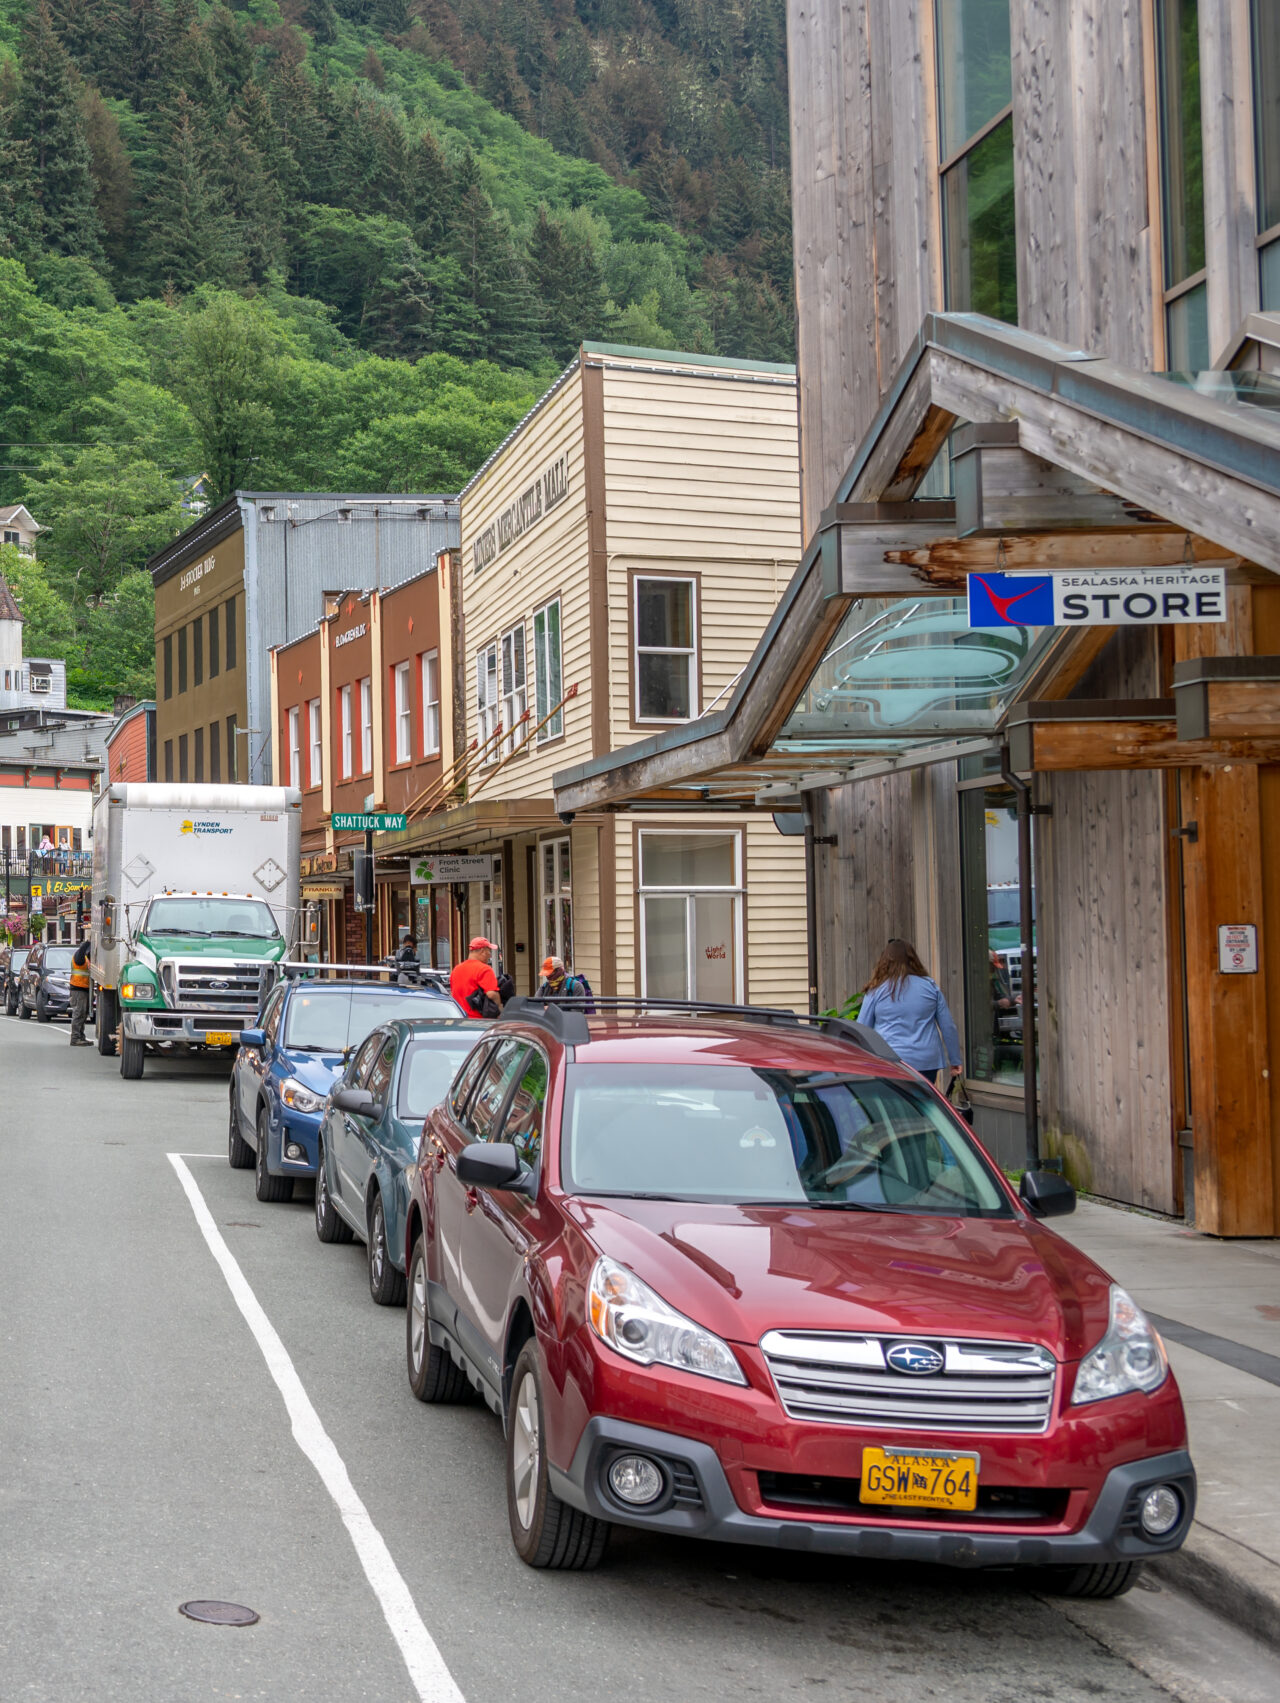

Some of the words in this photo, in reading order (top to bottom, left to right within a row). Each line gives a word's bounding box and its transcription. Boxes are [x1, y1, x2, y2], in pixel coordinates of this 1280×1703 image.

[1062, 577, 1138, 587] SEALASKA
[1143, 575, 1221, 585] HERITAGE
[1063, 592, 1221, 620] STORE
[335, 816, 380, 828] SHATTUCK
[384, 816, 403, 829] WAY
[461, 857, 484, 865] Street
[891, 1455, 951, 1468] ALASKA
[867, 1464, 910, 1493] GSW
[931, 1468, 971, 1497] 764
